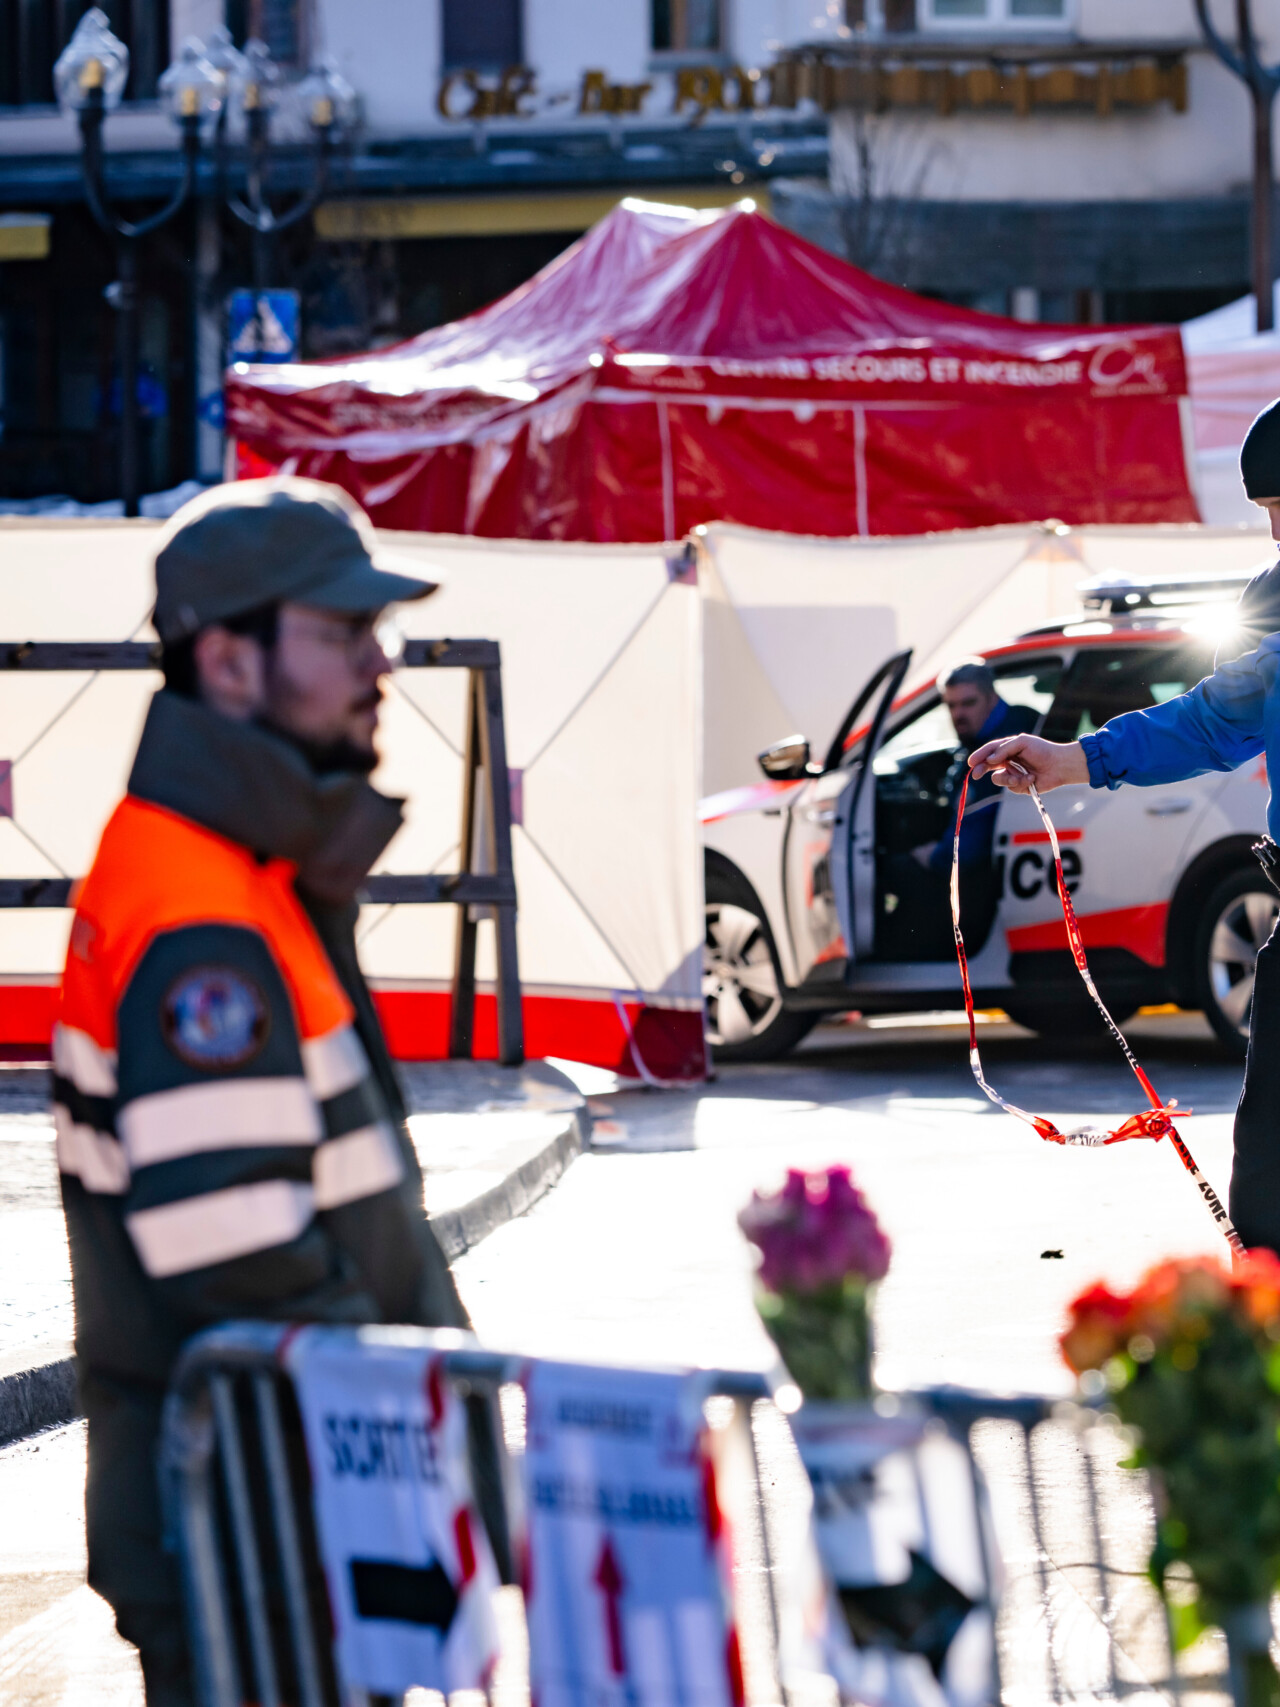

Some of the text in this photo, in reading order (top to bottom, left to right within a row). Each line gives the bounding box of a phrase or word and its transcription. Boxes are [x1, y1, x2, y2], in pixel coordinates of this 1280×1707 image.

[812, 357, 927, 383] SECOURS
[929, 358, 960, 383] ET
[964, 361, 1082, 386] INCENDIE
[998, 833, 1083, 901] ice
